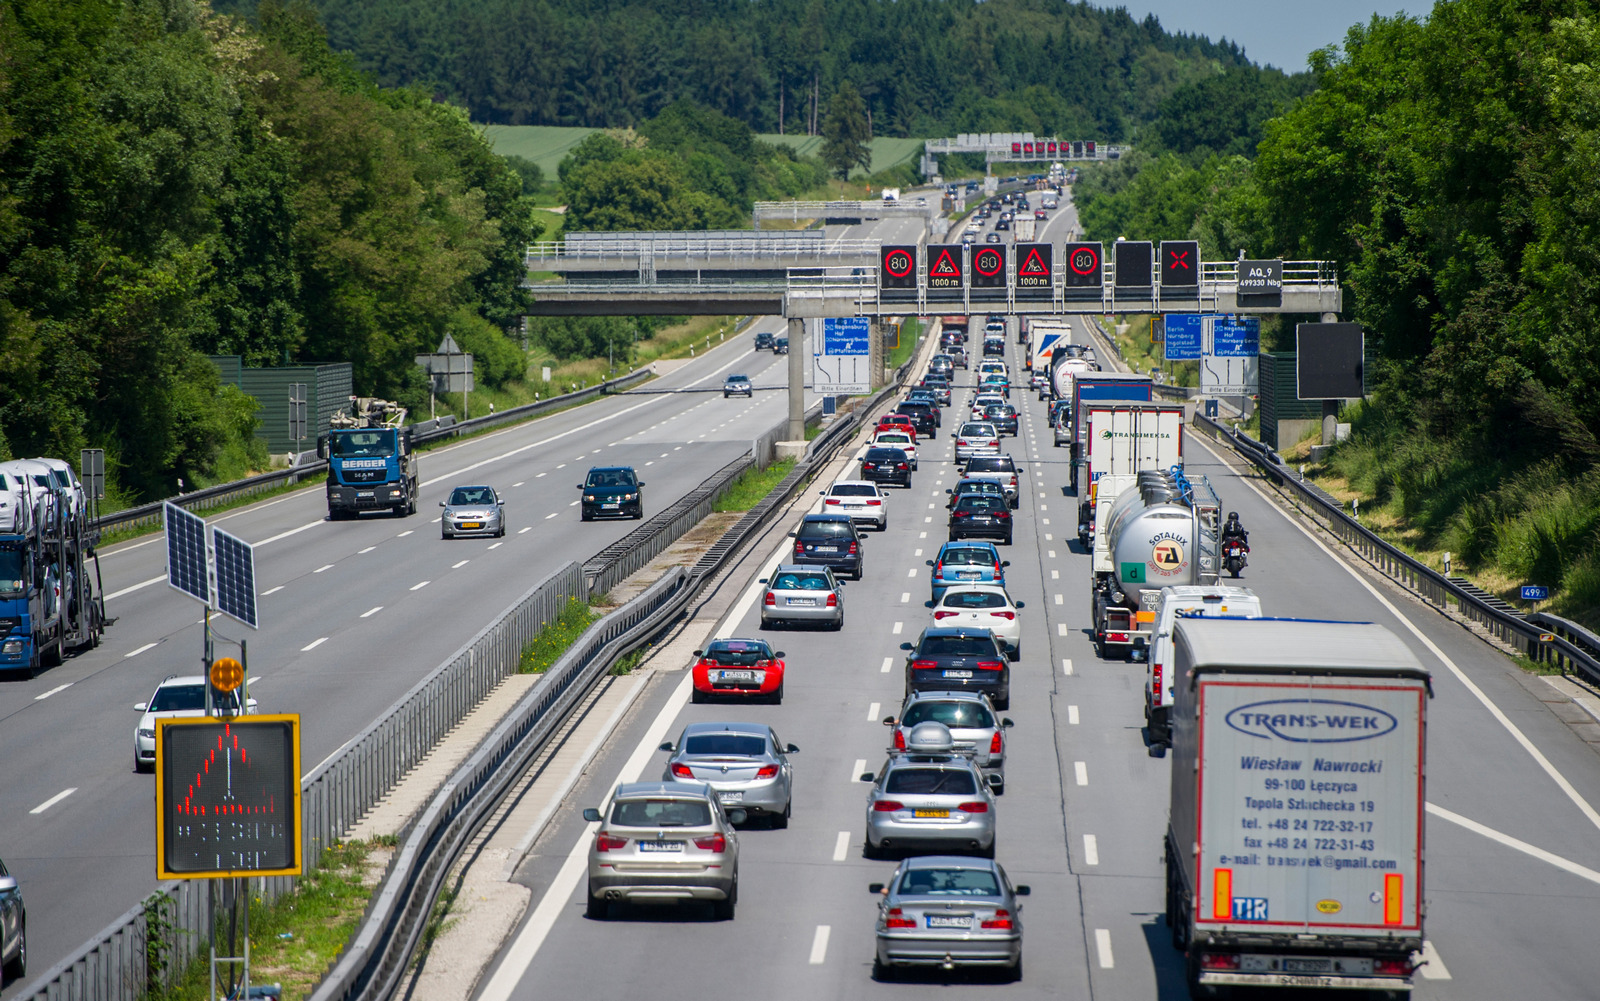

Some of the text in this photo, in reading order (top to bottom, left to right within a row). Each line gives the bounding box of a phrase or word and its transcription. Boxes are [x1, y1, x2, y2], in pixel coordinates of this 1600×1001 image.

[891, 257, 907, 270] 80
[981, 256, 997, 269] 80
[1076, 255, 1092, 267] 80
[1248, 268, 1273, 279] AQ_9
[931, 279, 949, 287] 1000
[1020, 278, 1038, 286] 1000
[1240, 279, 1281, 288] 499330 Nbg
[342, 459, 386, 468] BERGER
[1148, 531, 1188, 547] SOTALUX
[1130, 567, 1138, 579] d
[1240, 713, 1379, 730] TRANS-WEK
[1240, 756, 1383, 773] Wiesław Nawrocki
[1264, 778, 1358, 794] 99-100 Łęczyca
[1245, 796, 1284, 811] Topola
[1360, 801, 1375, 812] 19
[1242, 817, 1374, 833] tel. +48 24 722-32-17
[1244, 836, 1375, 851] fax +48 24 722-31-43
[1233, 898, 1267, 919] TIR
[1281, 976, 1332, 986] SCHMITZ
